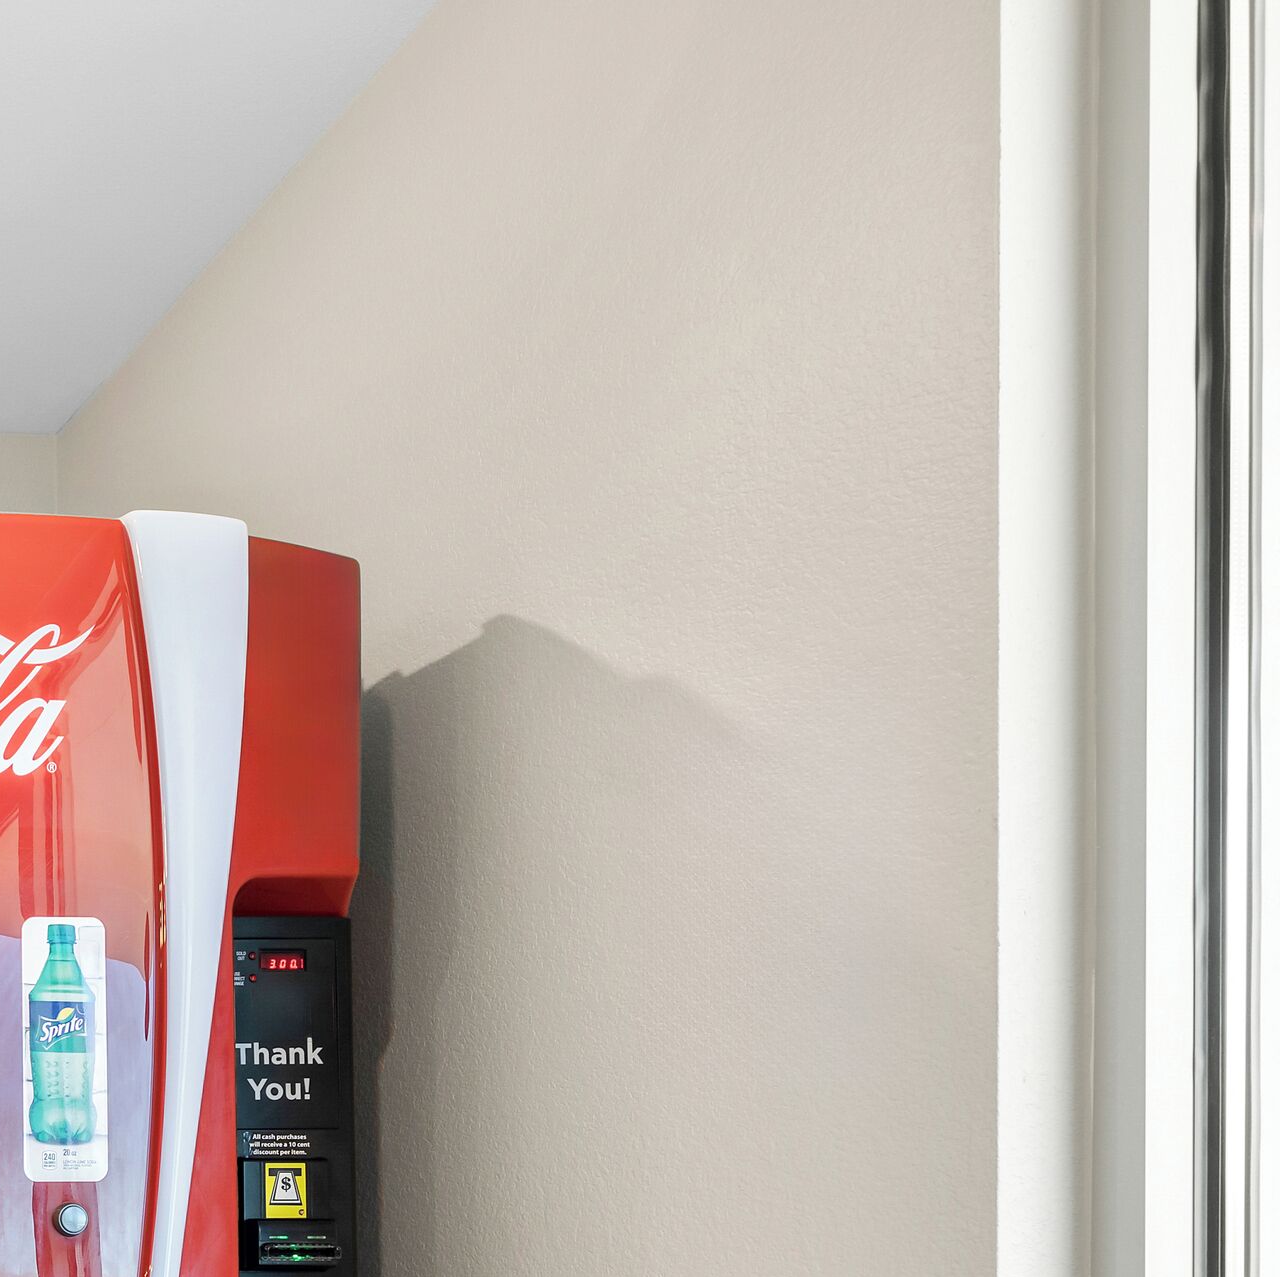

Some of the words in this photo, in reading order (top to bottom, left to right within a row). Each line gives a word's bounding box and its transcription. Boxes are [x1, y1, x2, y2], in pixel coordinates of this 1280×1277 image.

[39, 1018, 83, 1042] Sprite
[235, 1037, 324, 1065] Thank
[247, 1078, 311, 1100] You!
